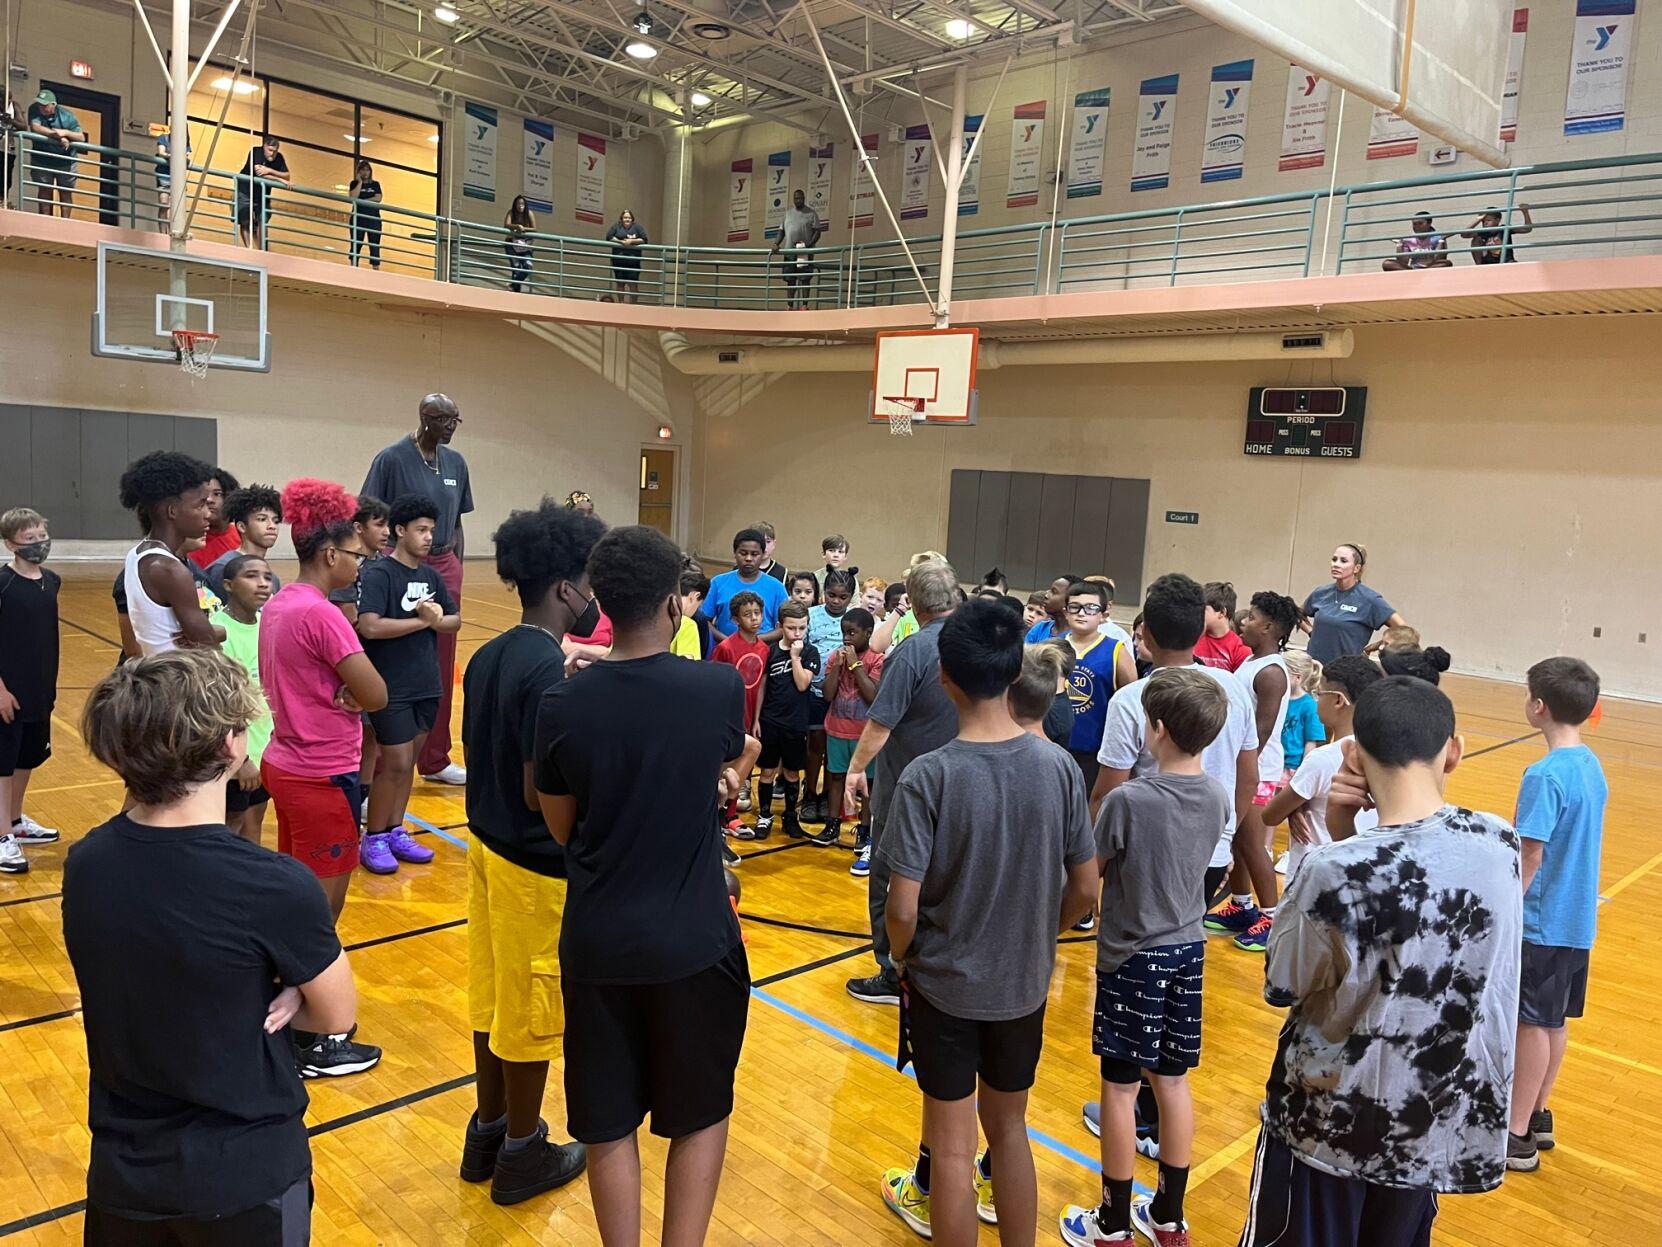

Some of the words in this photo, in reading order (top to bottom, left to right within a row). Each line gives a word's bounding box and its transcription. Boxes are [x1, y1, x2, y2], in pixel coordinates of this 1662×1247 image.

[1577, 60, 1598, 68] THANK
[1576, 67, 1590, 75] OUR
[1287, 416, 1315, 424] PERIOD
[1246, 444, 1273, 454] HOME
[1284, 447, 1311, 455] BONUS
[1321, 447, 1353, 456] GUESTS
[1170, 513, 1188, 521] Court
[407, 581, 429, 599] NIKE
[1073, 676, 1087, 687] 30
